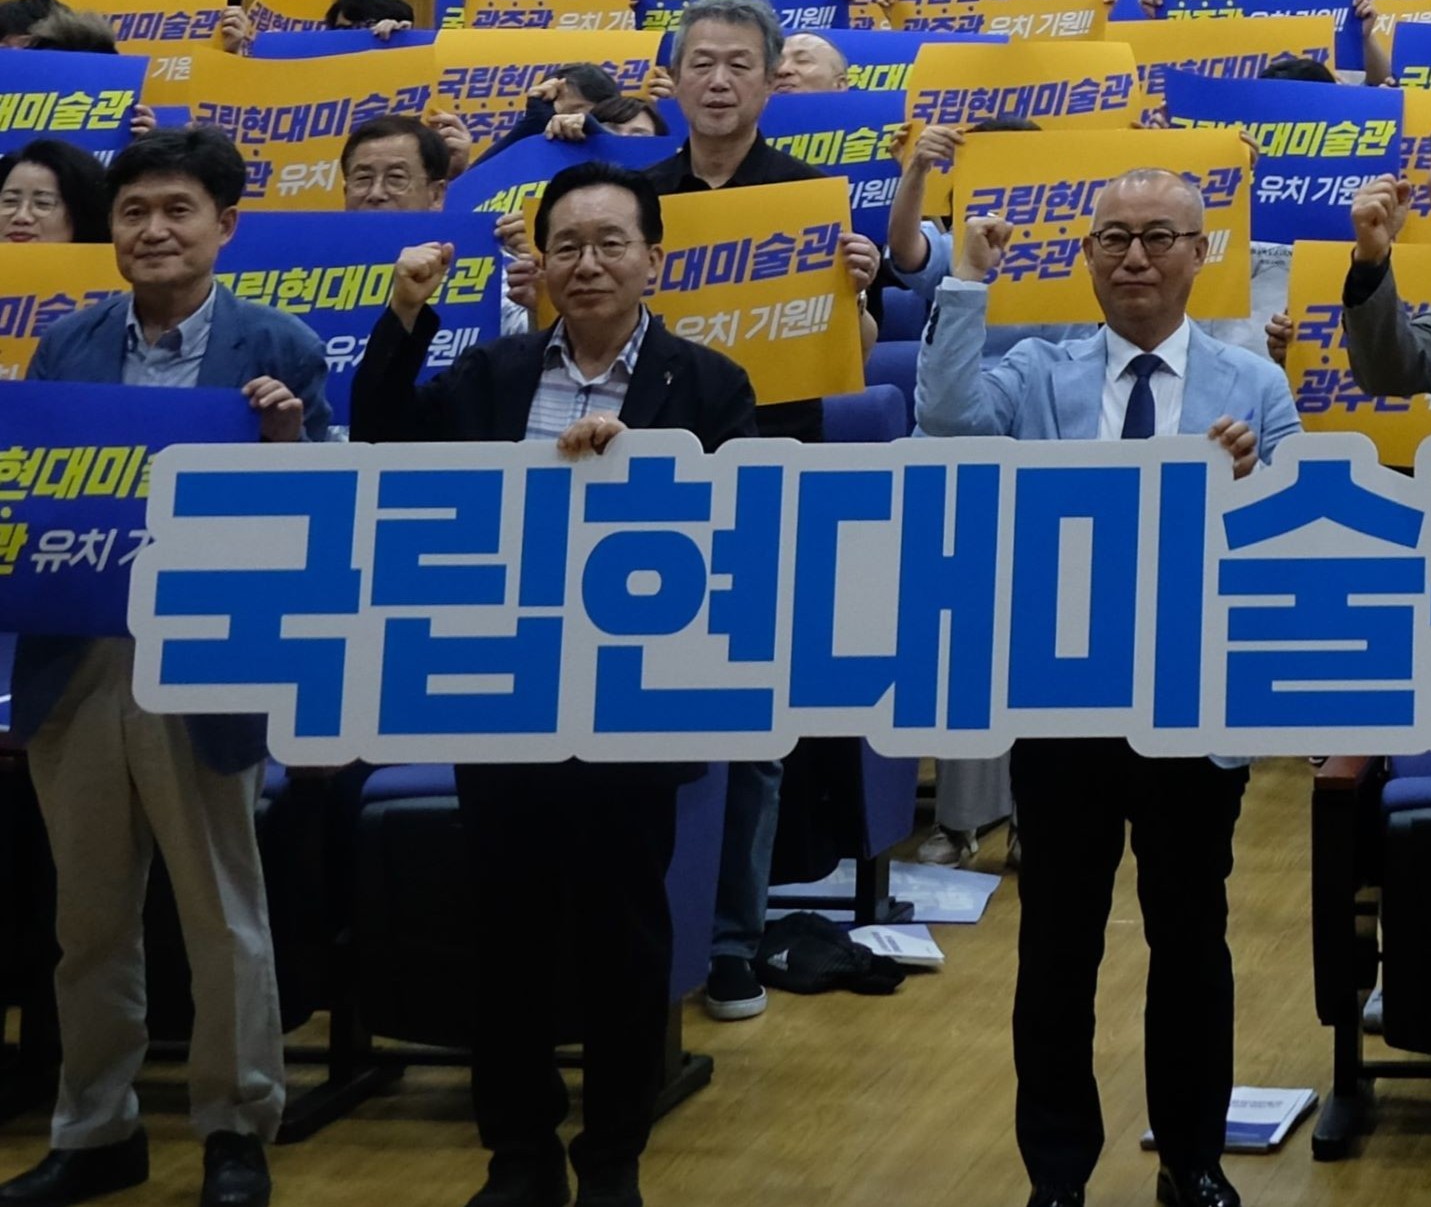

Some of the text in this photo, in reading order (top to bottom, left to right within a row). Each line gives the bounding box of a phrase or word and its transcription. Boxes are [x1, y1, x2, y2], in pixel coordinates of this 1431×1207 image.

[1035, 10, 1094, 38] 기원!!
[911, 73, 1135, 124] 국립현대미술관
[277, 159, 342, 196] 유치
[1257, 175, 1309, 205] 유치
[745, 294, 834, 341] 기원!!
[30, 529, 117, 573] 유치
